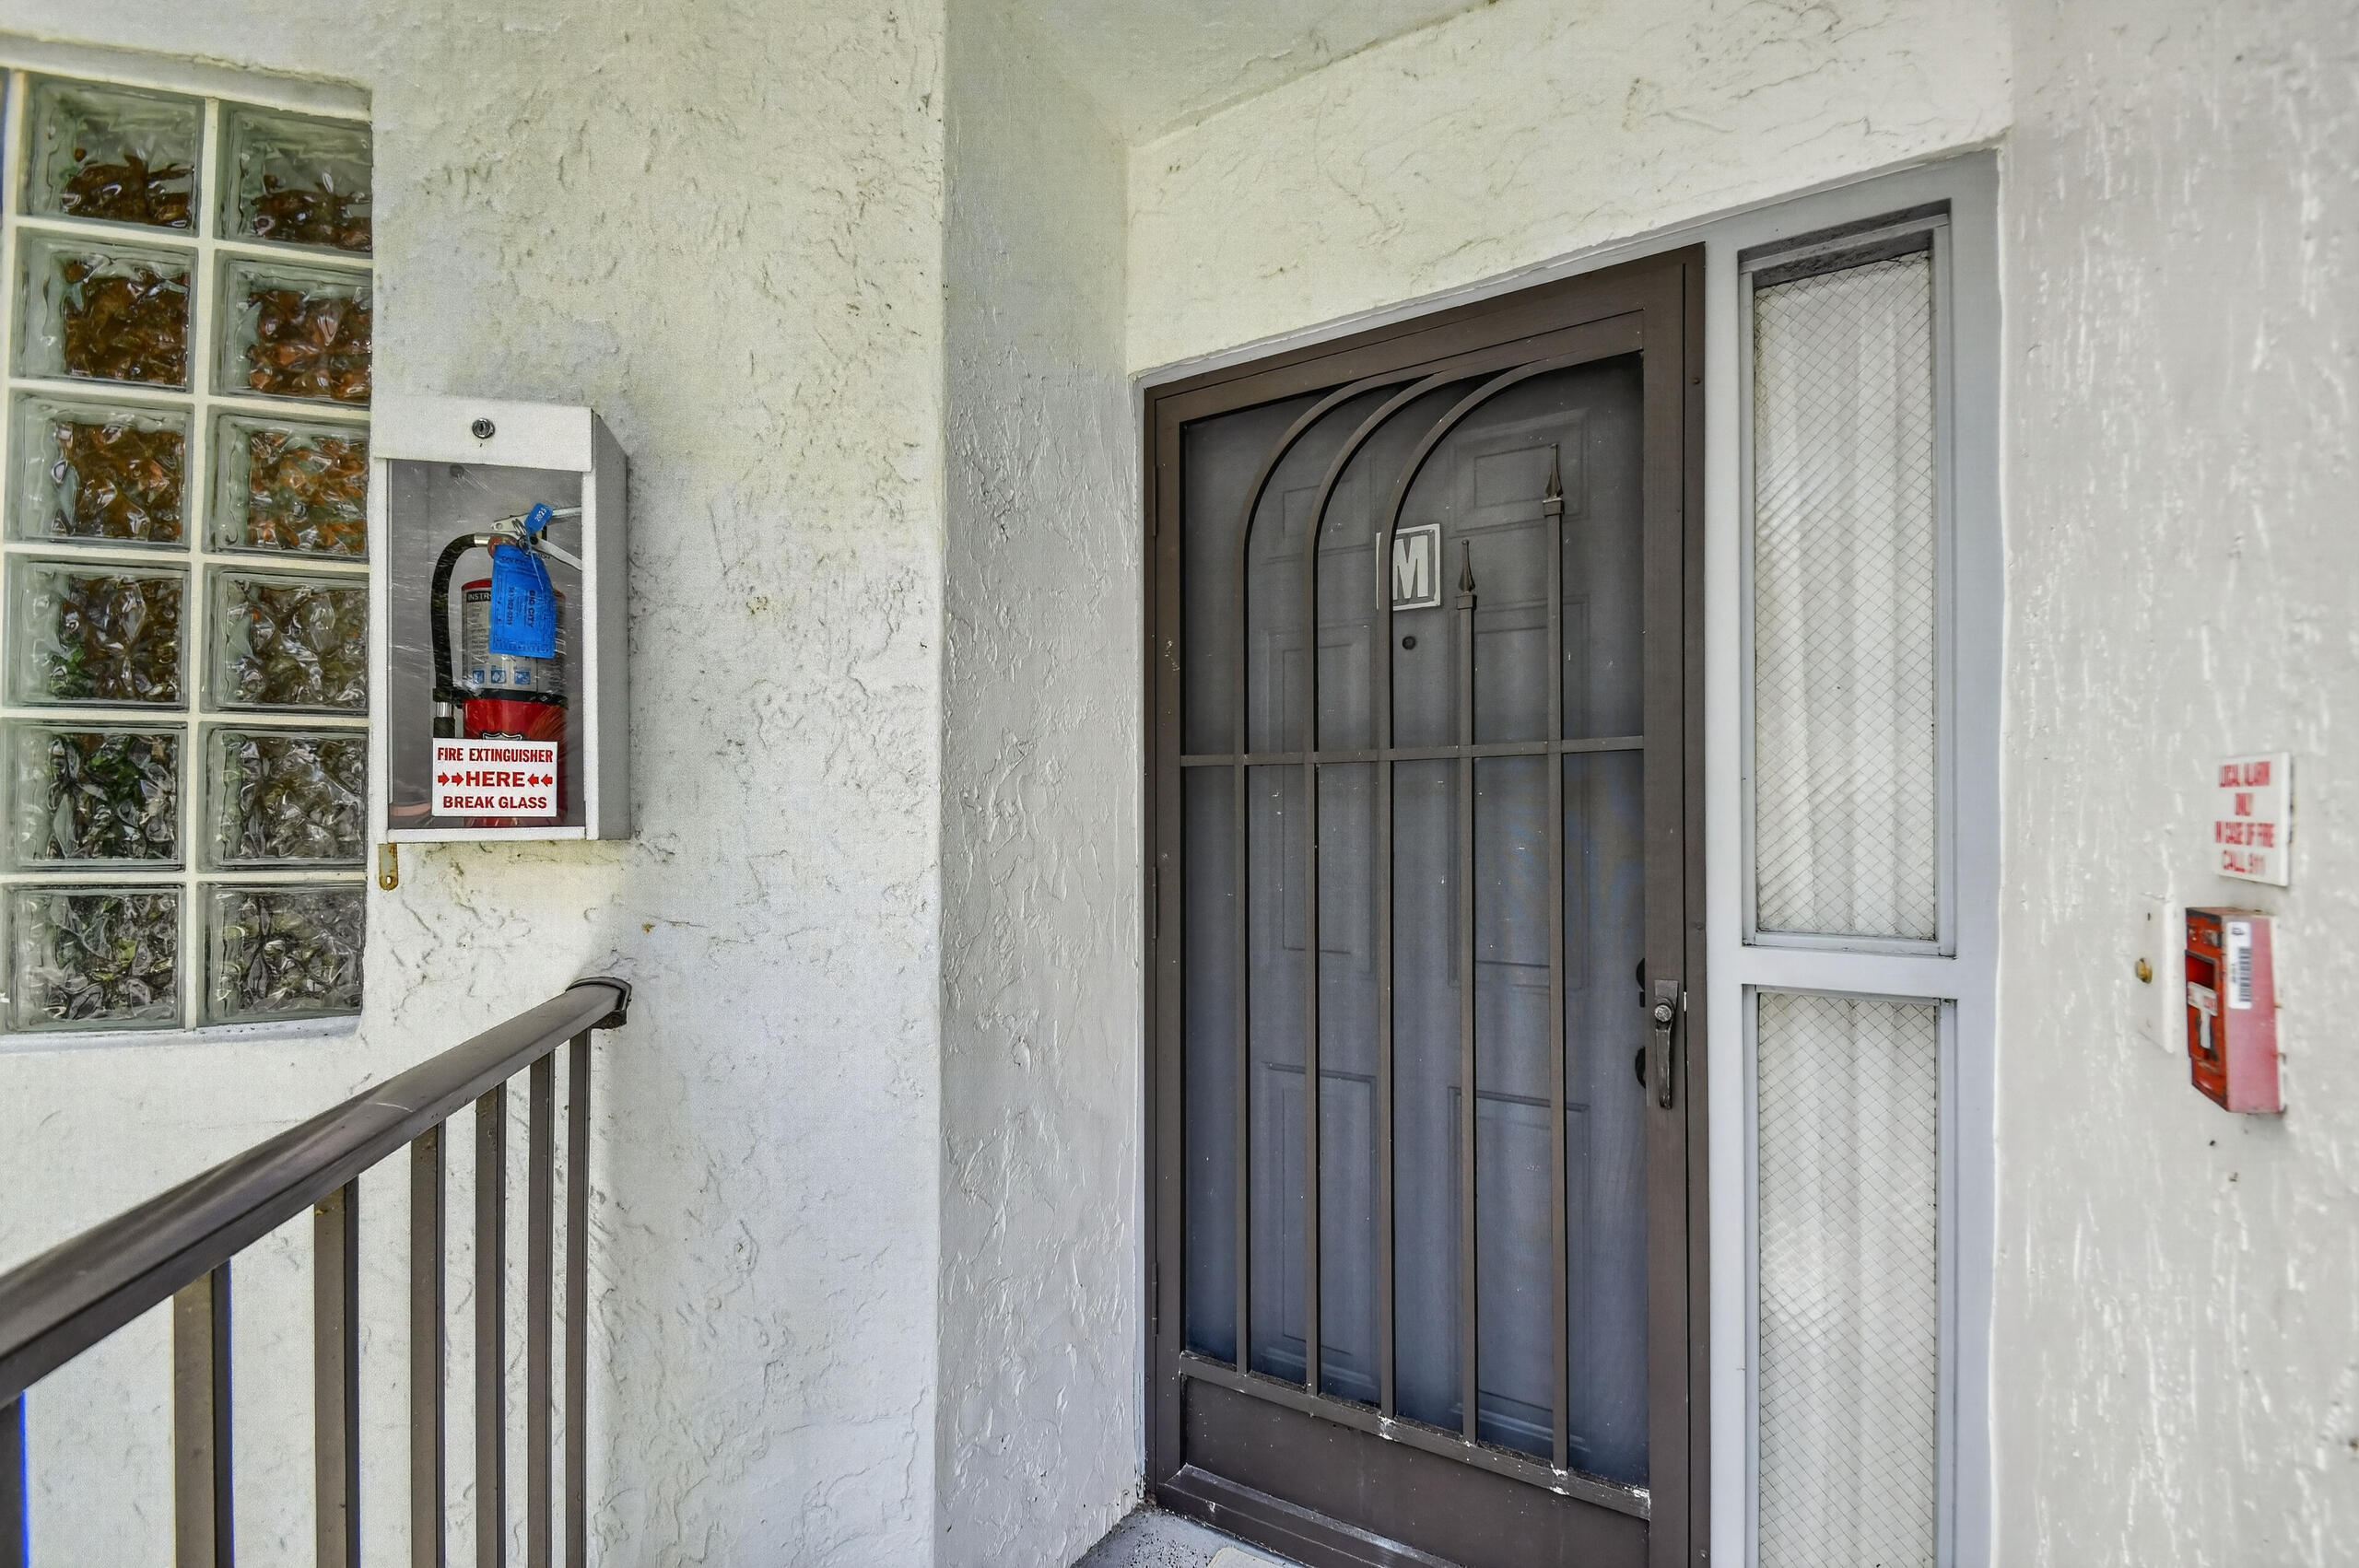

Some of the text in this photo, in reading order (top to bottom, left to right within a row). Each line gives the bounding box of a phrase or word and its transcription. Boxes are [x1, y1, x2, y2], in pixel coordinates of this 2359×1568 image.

[1392, 535, 1428, 601] M
[468, 592, 492, 602] INSTR
[438, 747, 553, 763] FIRE EXTINGUISHER
[466, 771, 525, 787] HERE
[443, 796, 547, 809] BREAK GLASS
